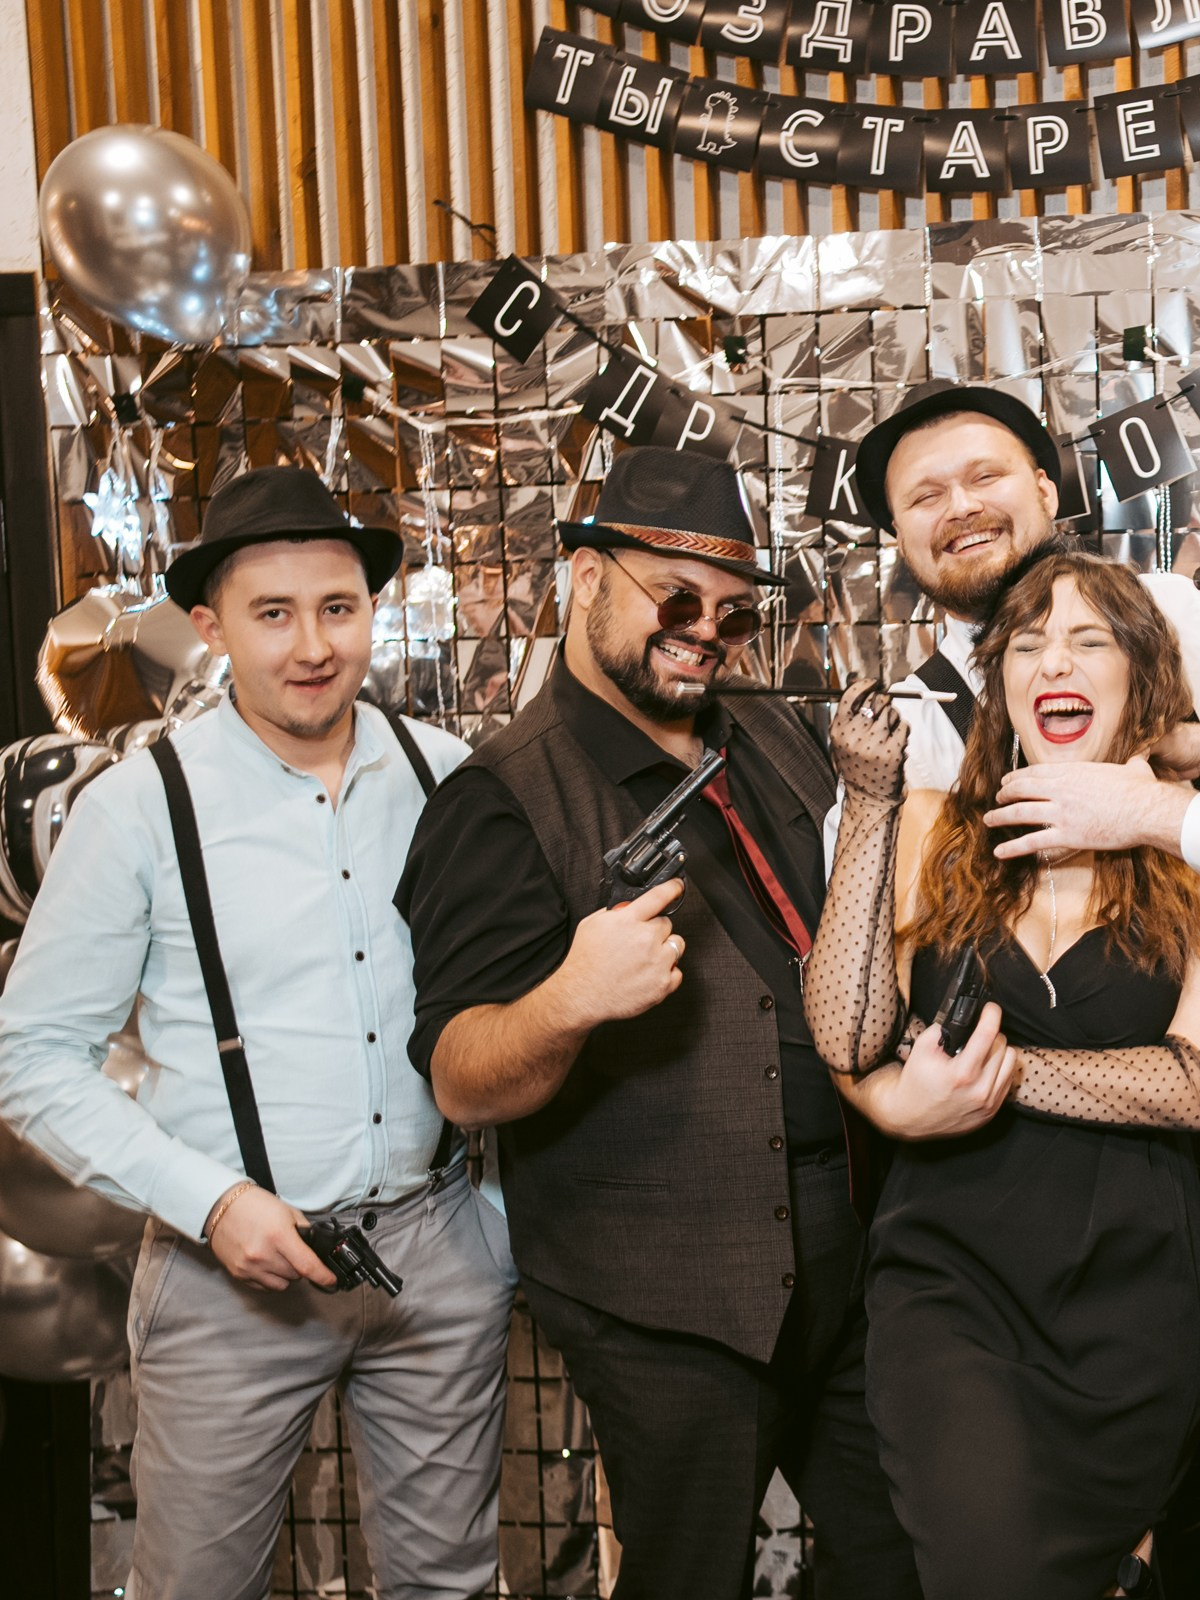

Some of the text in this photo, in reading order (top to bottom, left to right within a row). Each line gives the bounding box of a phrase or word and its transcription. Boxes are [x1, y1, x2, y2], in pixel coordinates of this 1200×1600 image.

[554, 43, 673, 134] ТЫ
[493, 280, 541, 338] С
[599, 363, 717, 451] ДР
